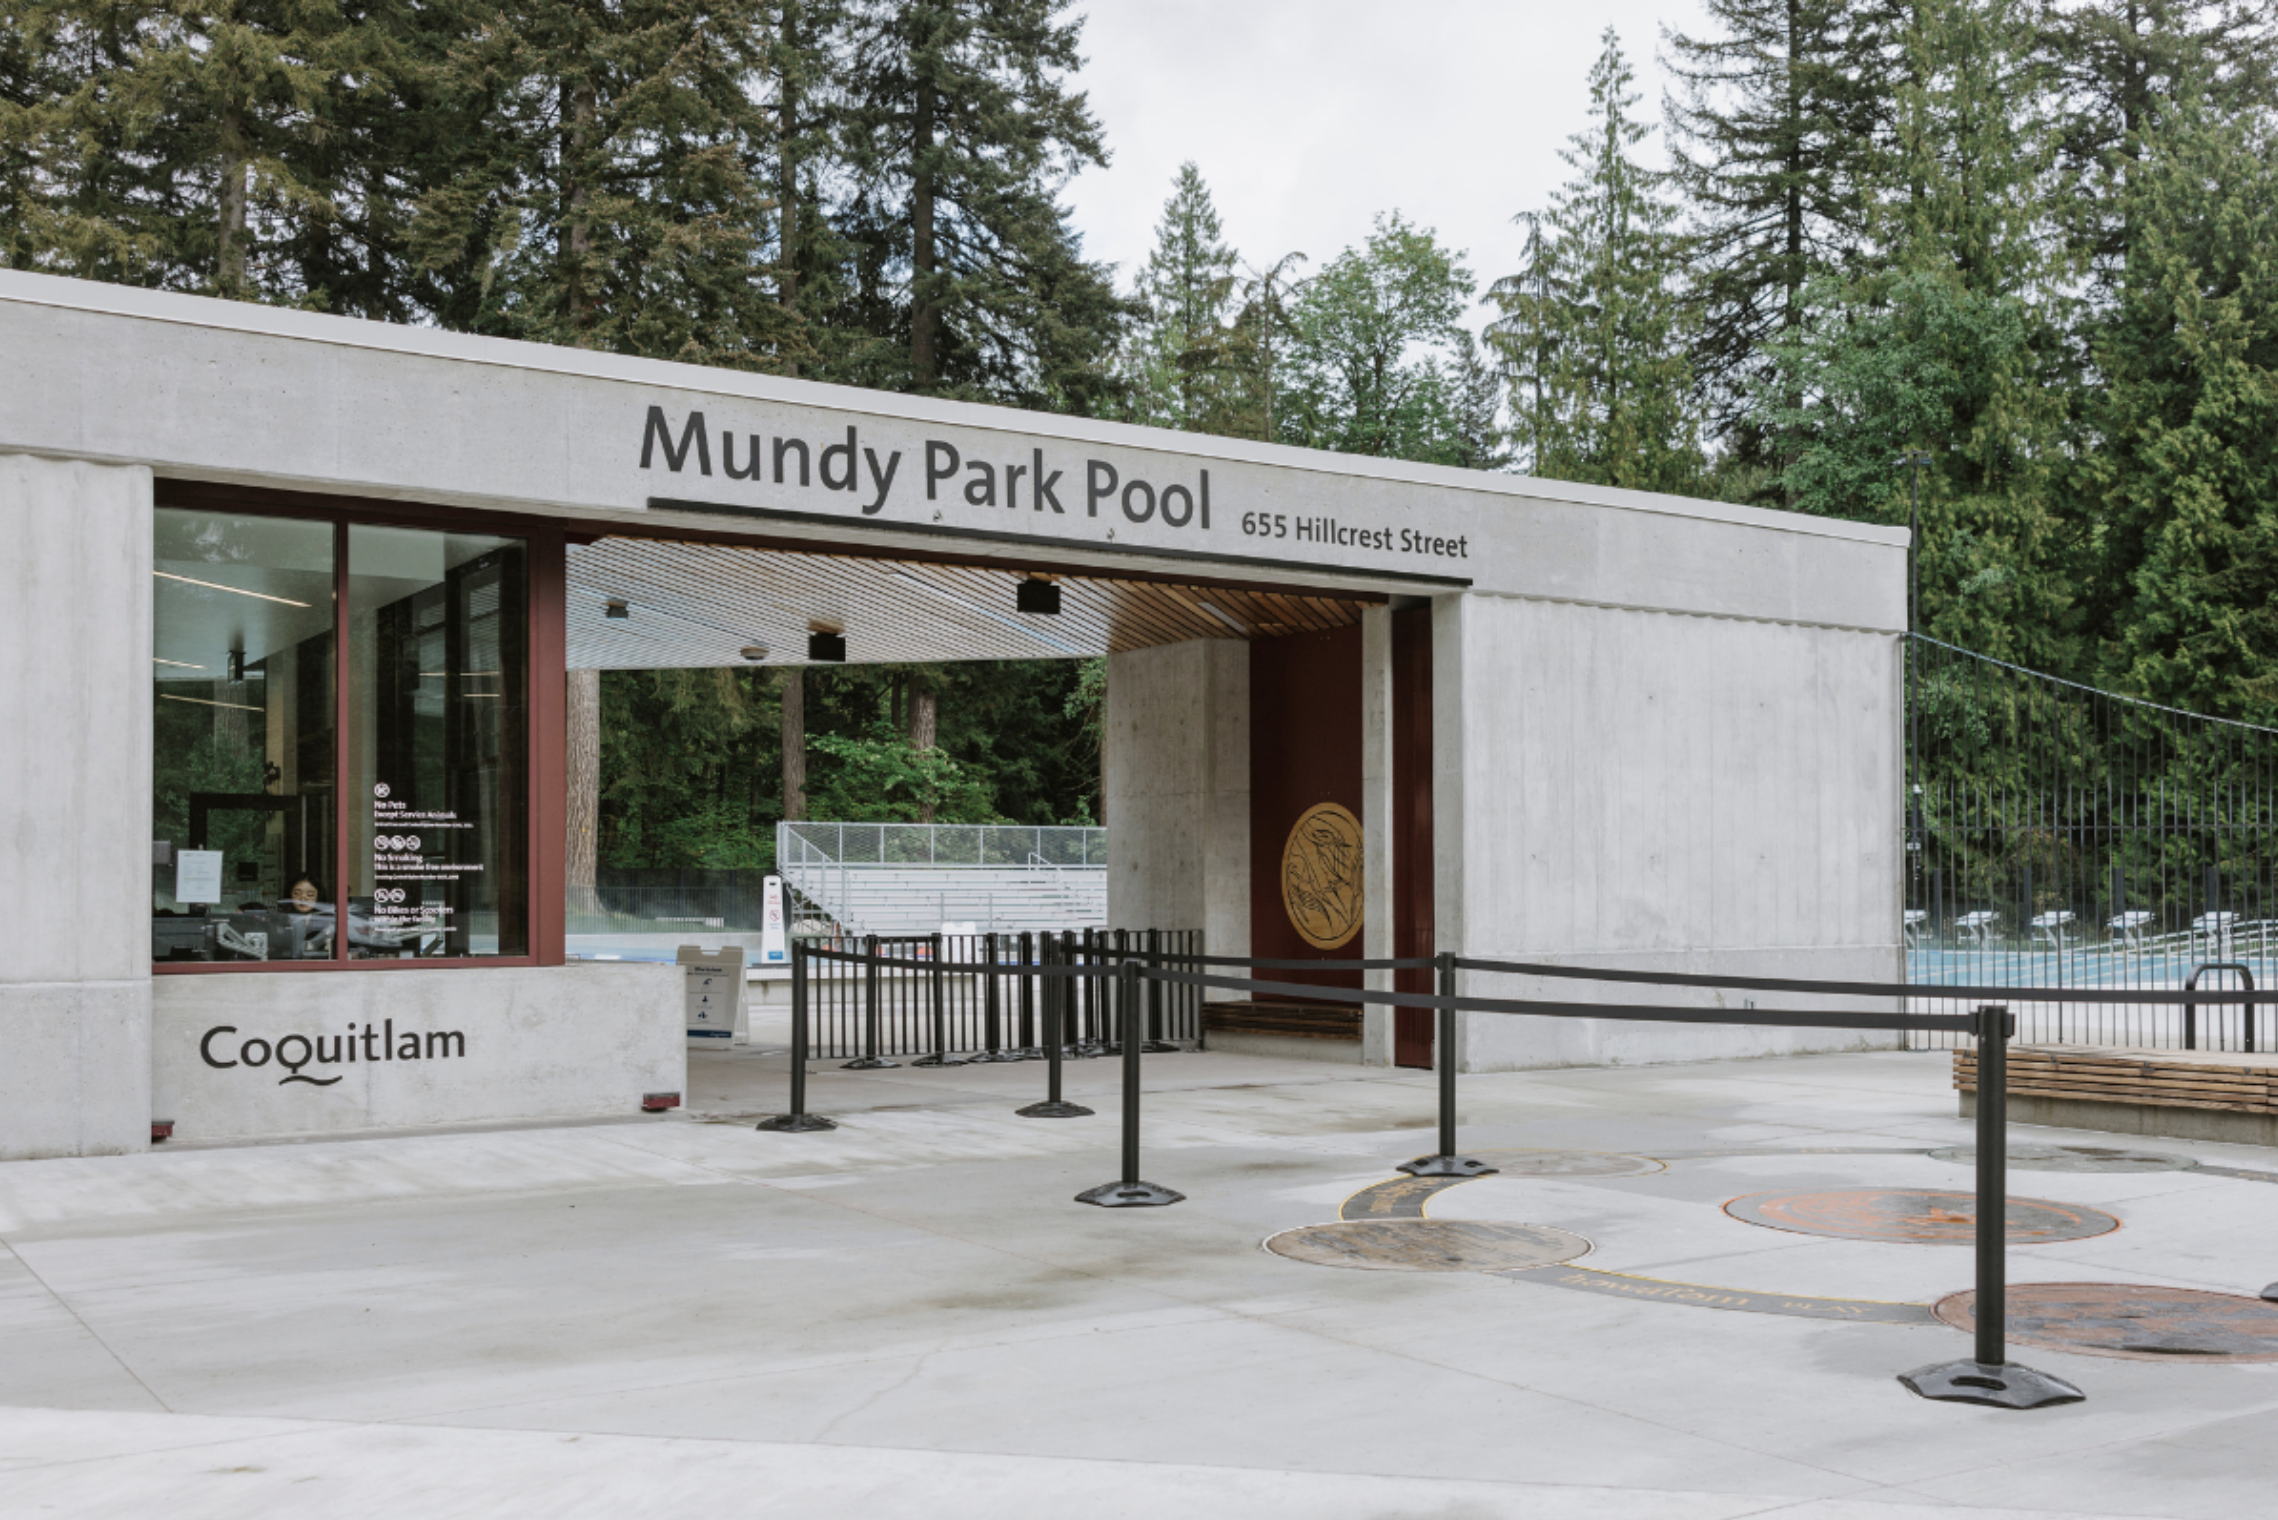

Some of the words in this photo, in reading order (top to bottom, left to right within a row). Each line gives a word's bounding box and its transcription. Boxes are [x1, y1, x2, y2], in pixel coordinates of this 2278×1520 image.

[639, 405, 902, 516] Mundy
[924, 438, 1065, 514] Park
[1086, 459, 1210, 529] Pool
[1241, 511, 1288, 540] 655
[1296, 515, 1393, 552] Hillcrest
[1400, 528, 1468, 559] Street
[374, 801, 386, 809] No
[387, 801, 406, 809] Pets
[374, 811, 398, 820] Except
[427, 811, 457, 819] Animals
[374, 853, 386, 862] No
[387, 853, 423, 863] Smoking
[374, 905, 386, 914] No
[387, 905, 409, 914] Bikes
[410, 906, 419, 914] or
